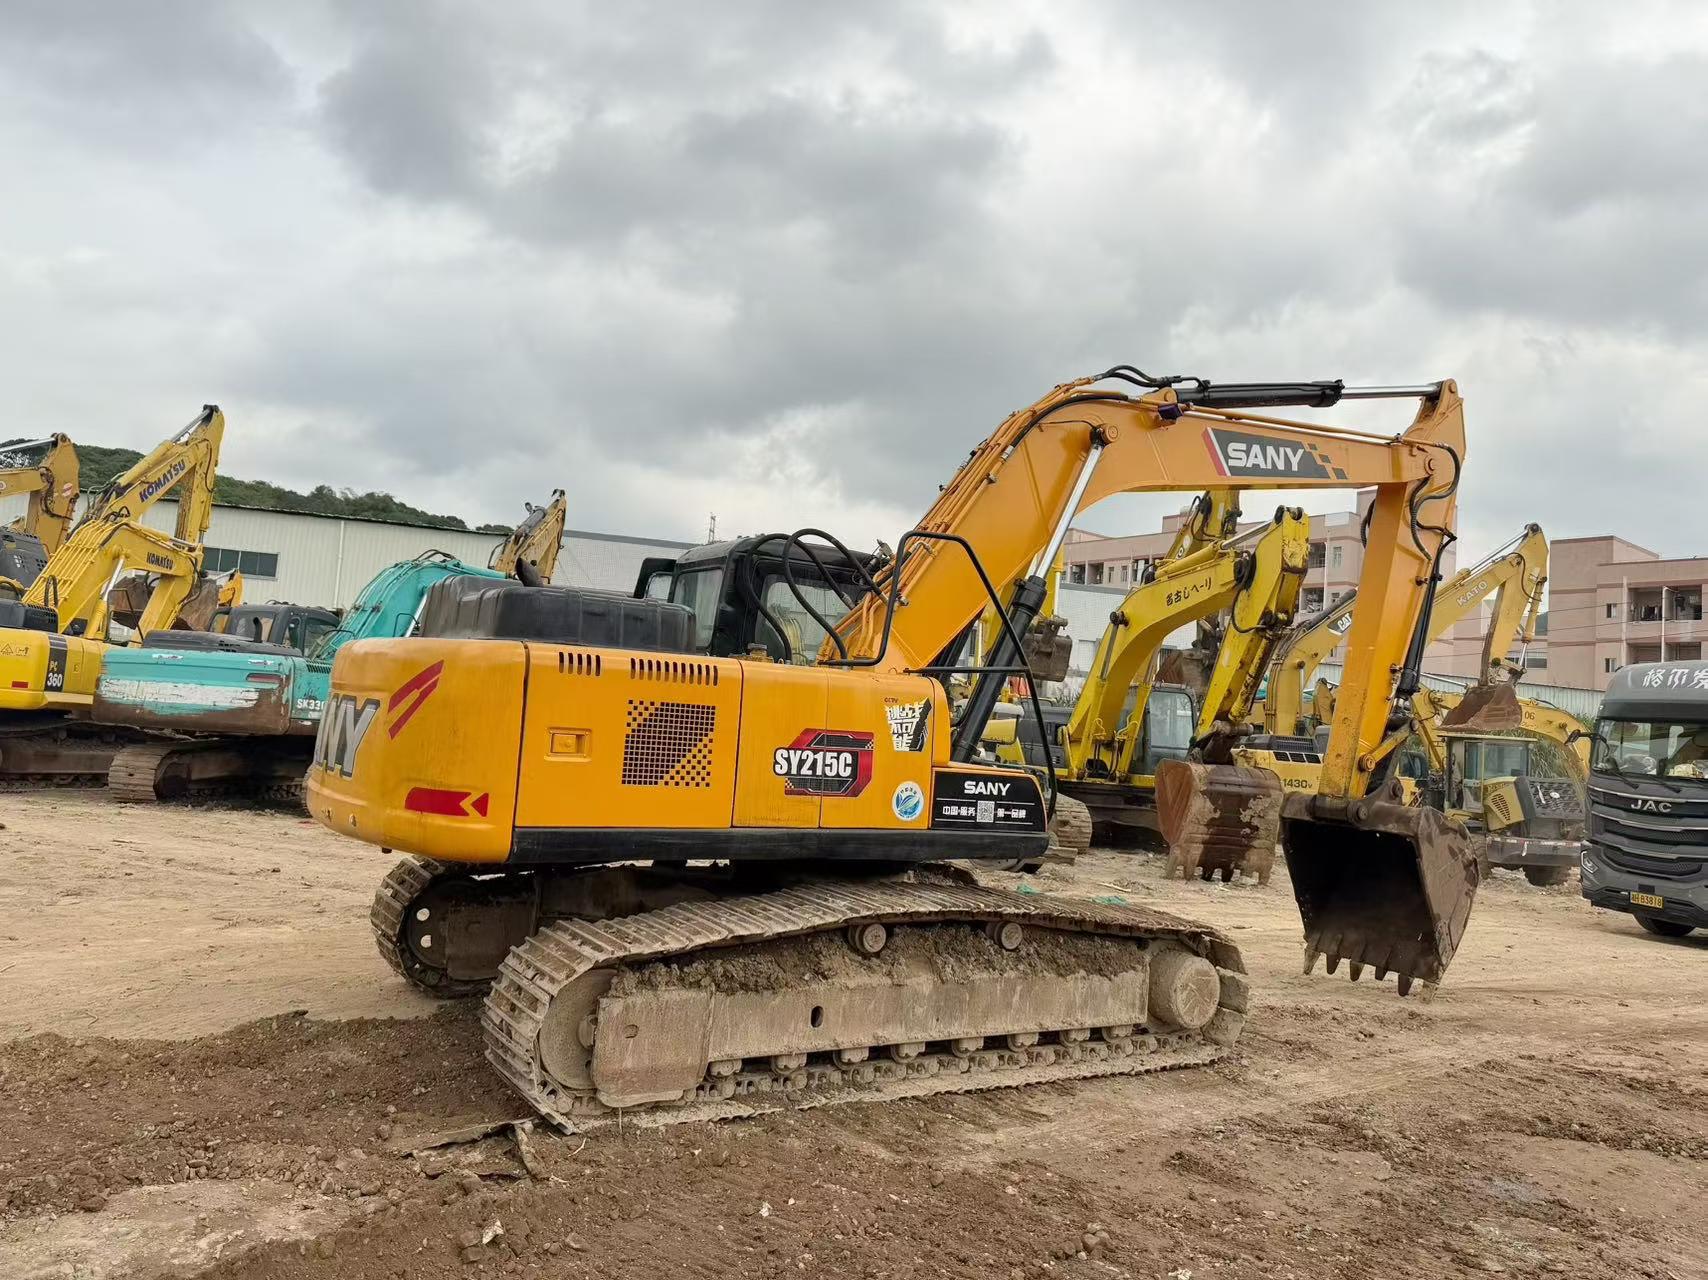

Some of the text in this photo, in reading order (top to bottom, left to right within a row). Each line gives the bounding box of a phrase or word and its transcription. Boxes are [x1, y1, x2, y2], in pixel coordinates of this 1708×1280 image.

[1227, 442, 1305, 472] SANY
[139, 459, 186, 502] KOMATSU
[146, 552, 174, 570] KOMATSU
[1457, 580, 1488, 606] KATO
[1337, 612, 1352, 632] CAT
[50, 660, 59, 672] PC
[47, 672, 63, 687] 360
[314, 697, 380, 778] NY
[774, 748, 853, 777] SY215C
[963, 780, 1011, 796] SANY
[996, 807, 1027, 819] 第一品牌
[1630, 799, 1672, 813] JAC
